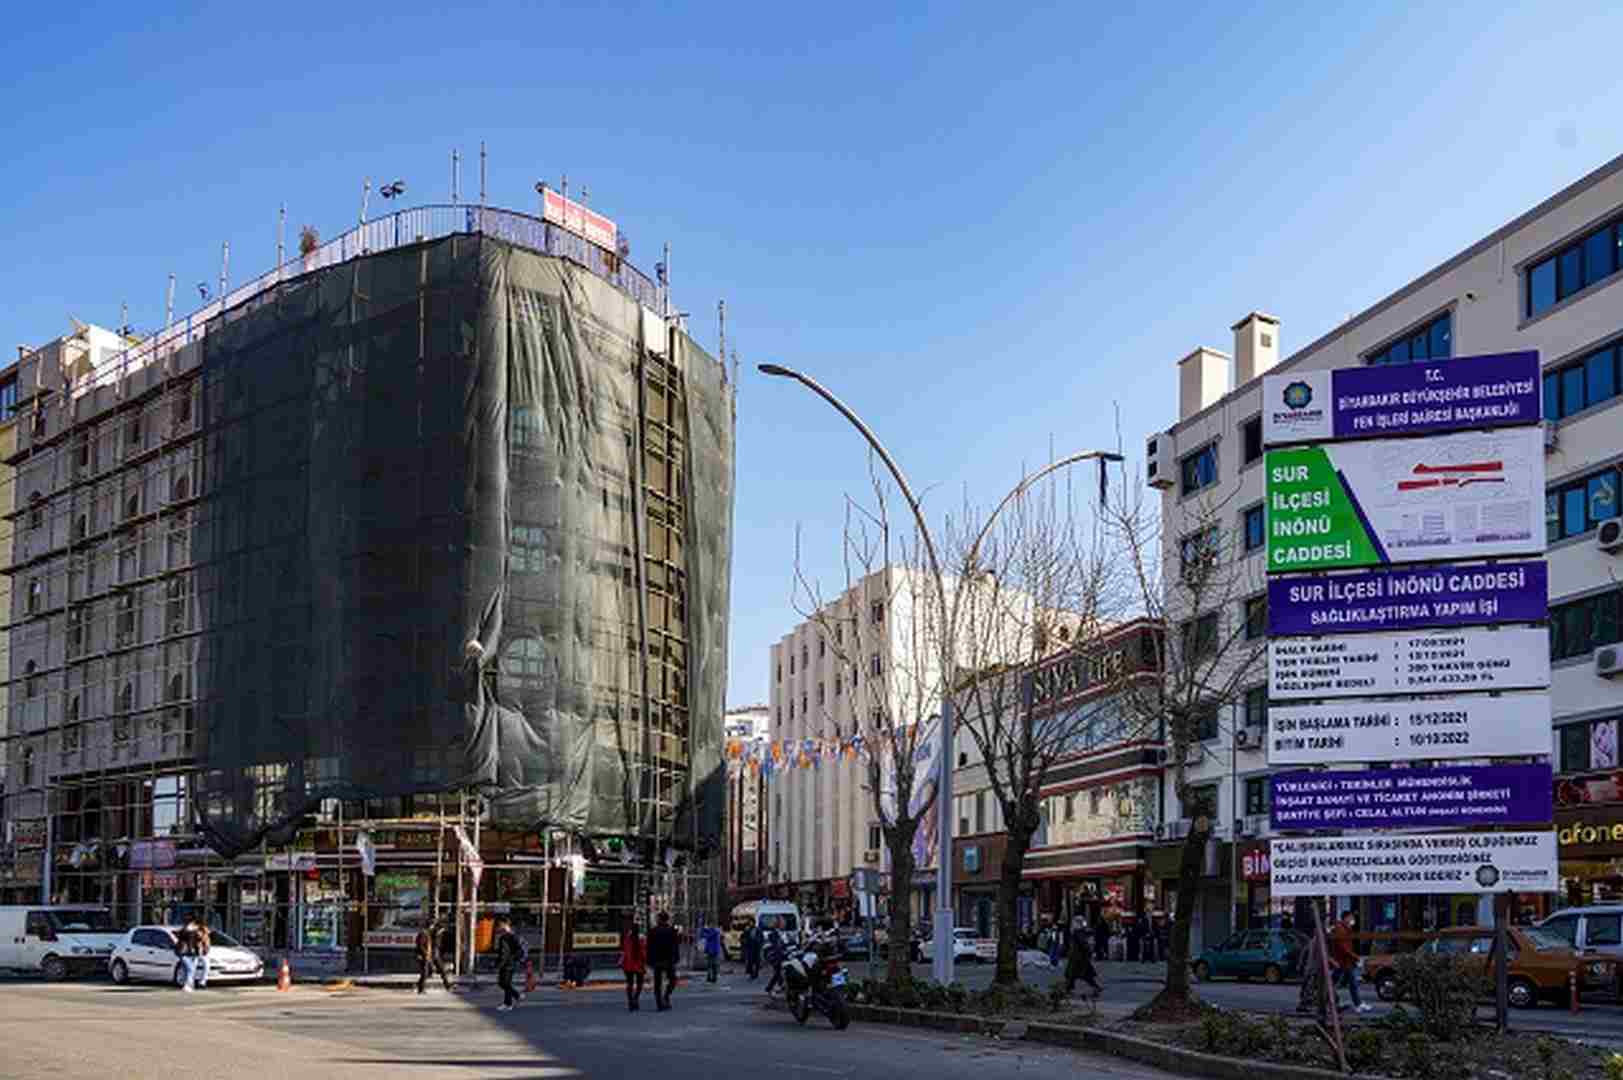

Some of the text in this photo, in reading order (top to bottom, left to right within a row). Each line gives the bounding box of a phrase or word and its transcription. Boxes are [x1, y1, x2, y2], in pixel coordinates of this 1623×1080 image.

[1425, 369, 1445, 382] T.C.
[1472, 377, 1534, 399] BELEDİYESİ
[1272, 465, 1309, 482] SUR
[1273, 487, 1330, 512] İLÇESİ
[1273, 514, 1331, 536] İNÖNÜ
[1273, 539, 1351, 564] CADDESİ
[1289, 568, 1525, 603] SUR İLÇESİ İNÖNÜ CADDESİ
[1311, 597, 1498, 625] SAĞLIKLAŞTIRMA YAPIM İŞİ
[1299, 717, 1350, 732] BAŞLAMA
